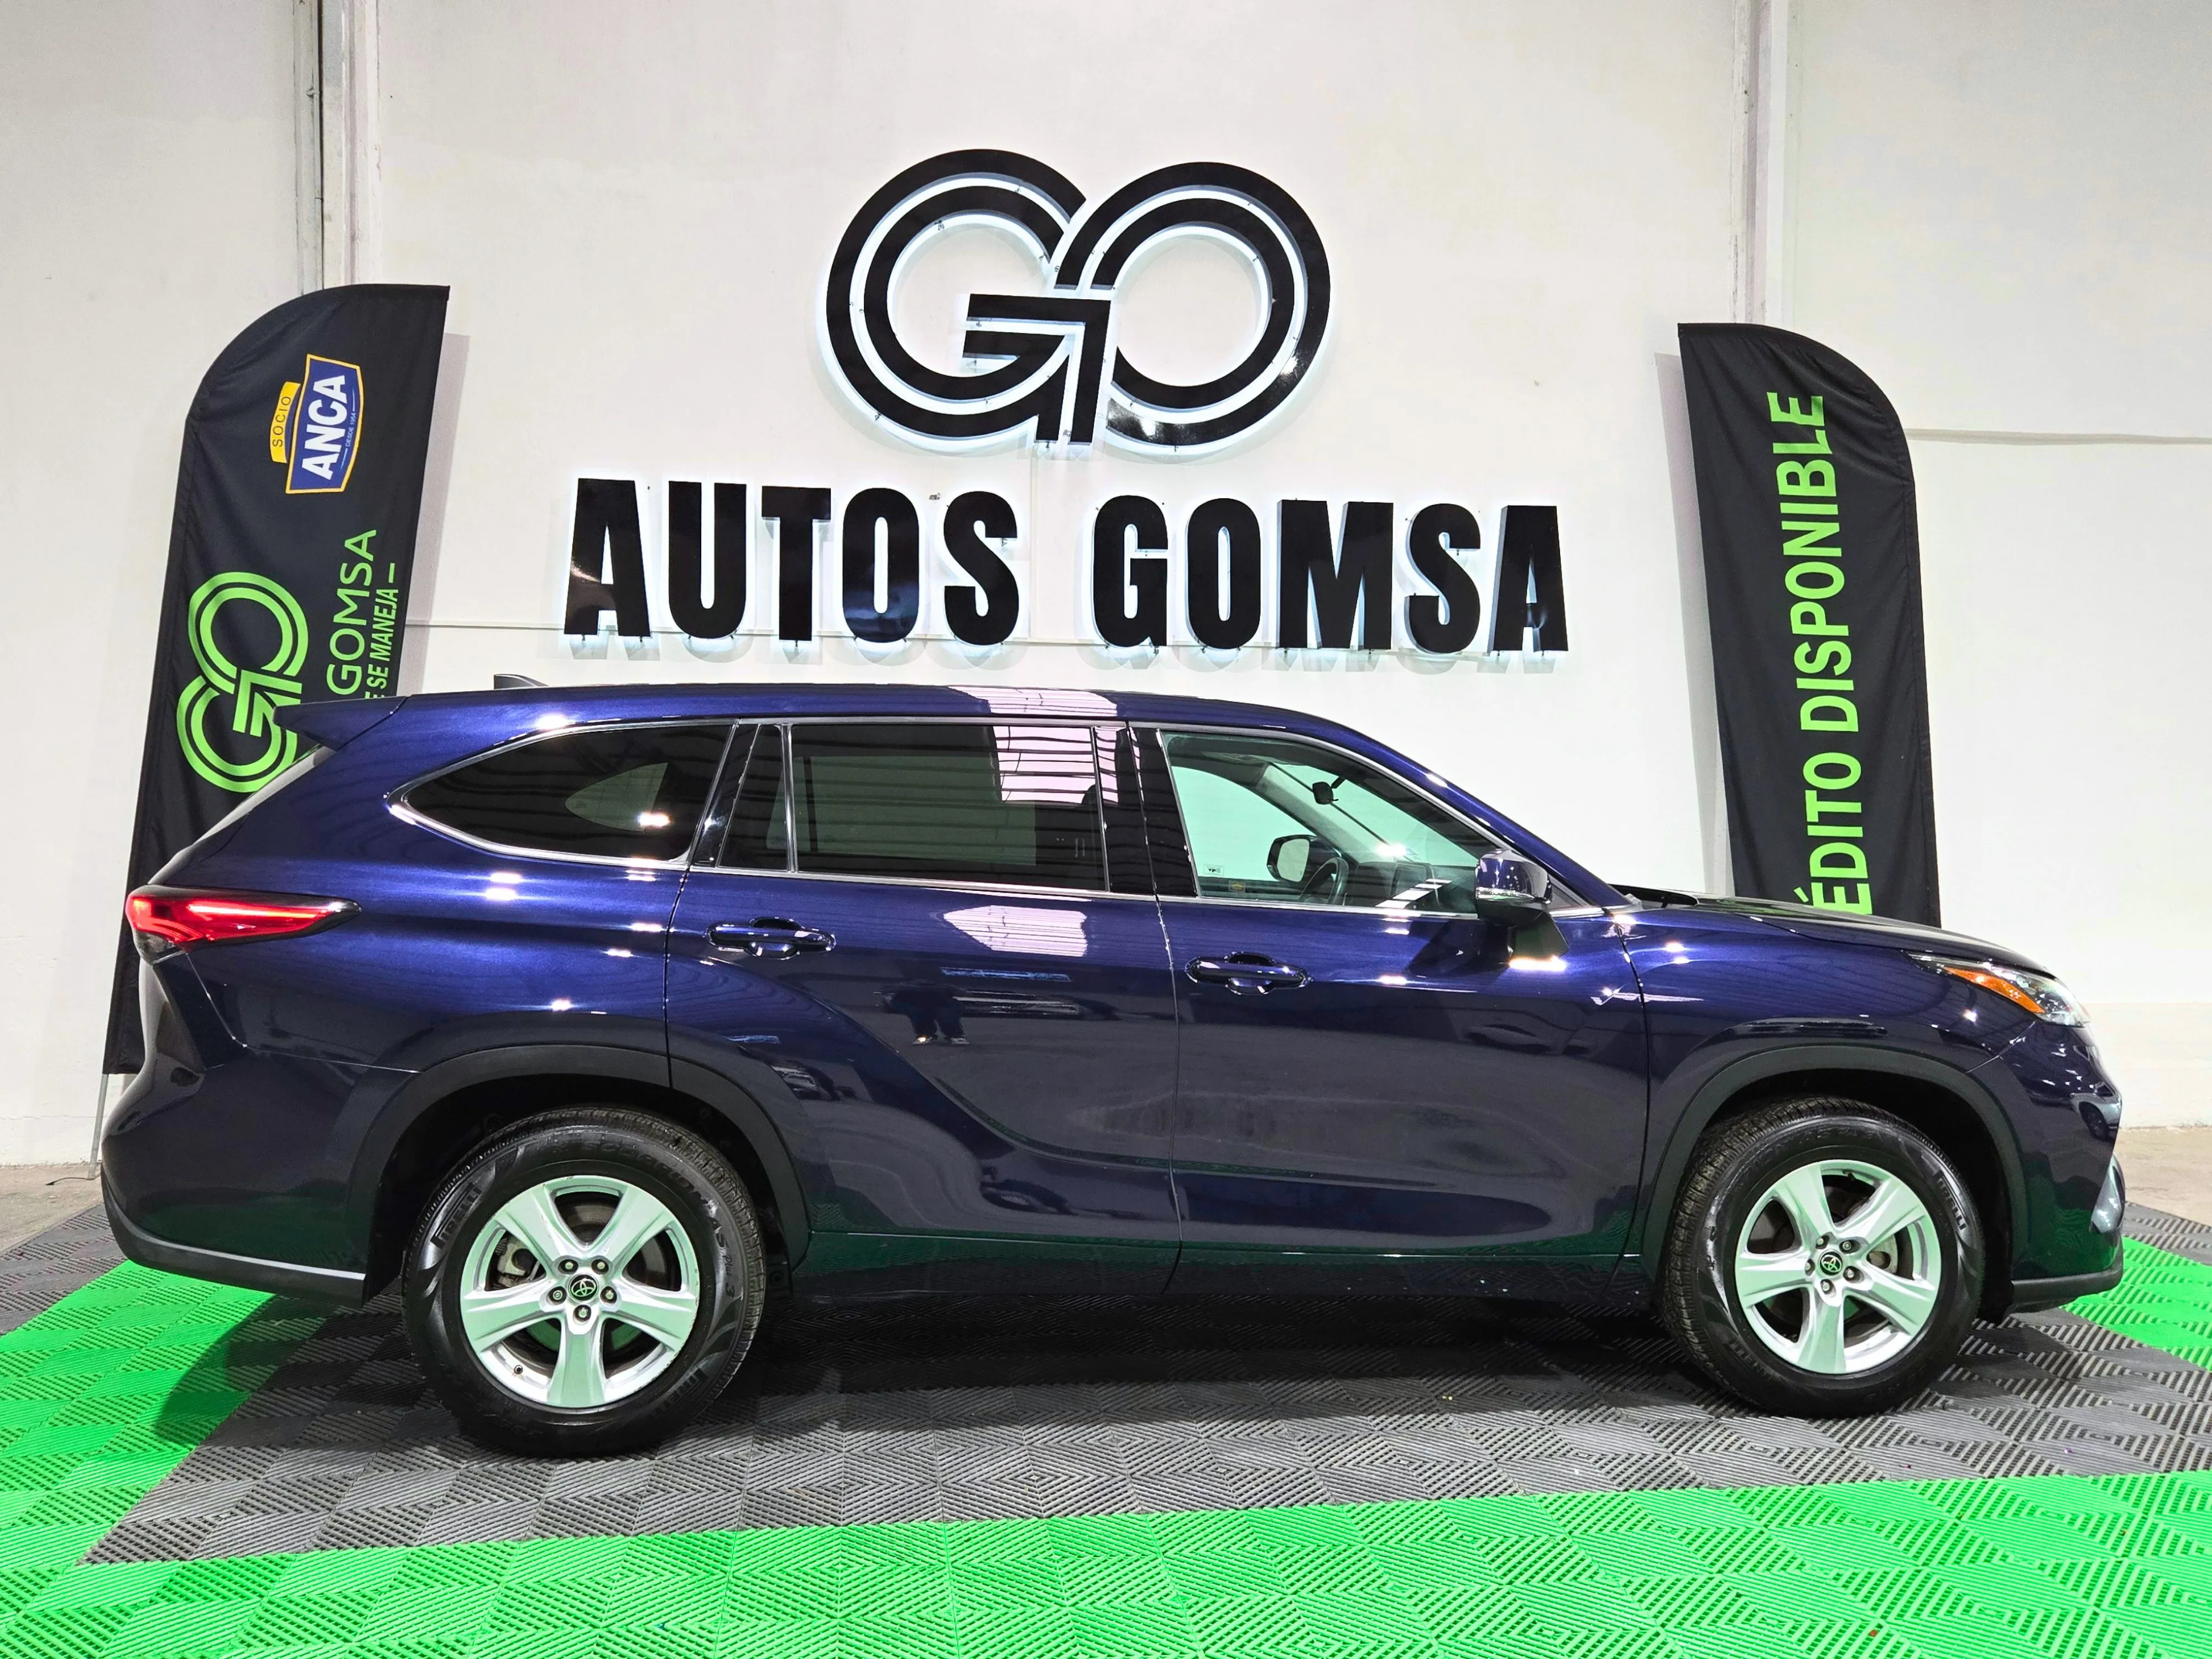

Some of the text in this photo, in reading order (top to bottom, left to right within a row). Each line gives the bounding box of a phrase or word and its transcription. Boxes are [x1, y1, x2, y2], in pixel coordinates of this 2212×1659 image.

[826, 149, 1331, 445] GO
[272, 396, 291, 447] SOCIO
[301, 375, 347, 480] ANCA
[564, 479, 1569, 653] AUTOS GOMSA
[1766, 392, 1859, 733] DISPONIBLE
[326, 529, 377, 695] GOMSA
[369, 589, 399, 661] MANEJA
[366, 664, 389, 689] SE
[430, 1182, 483, 1249] PIRELLI
[1933, 1170, 1970, 1230] PIRELLI
